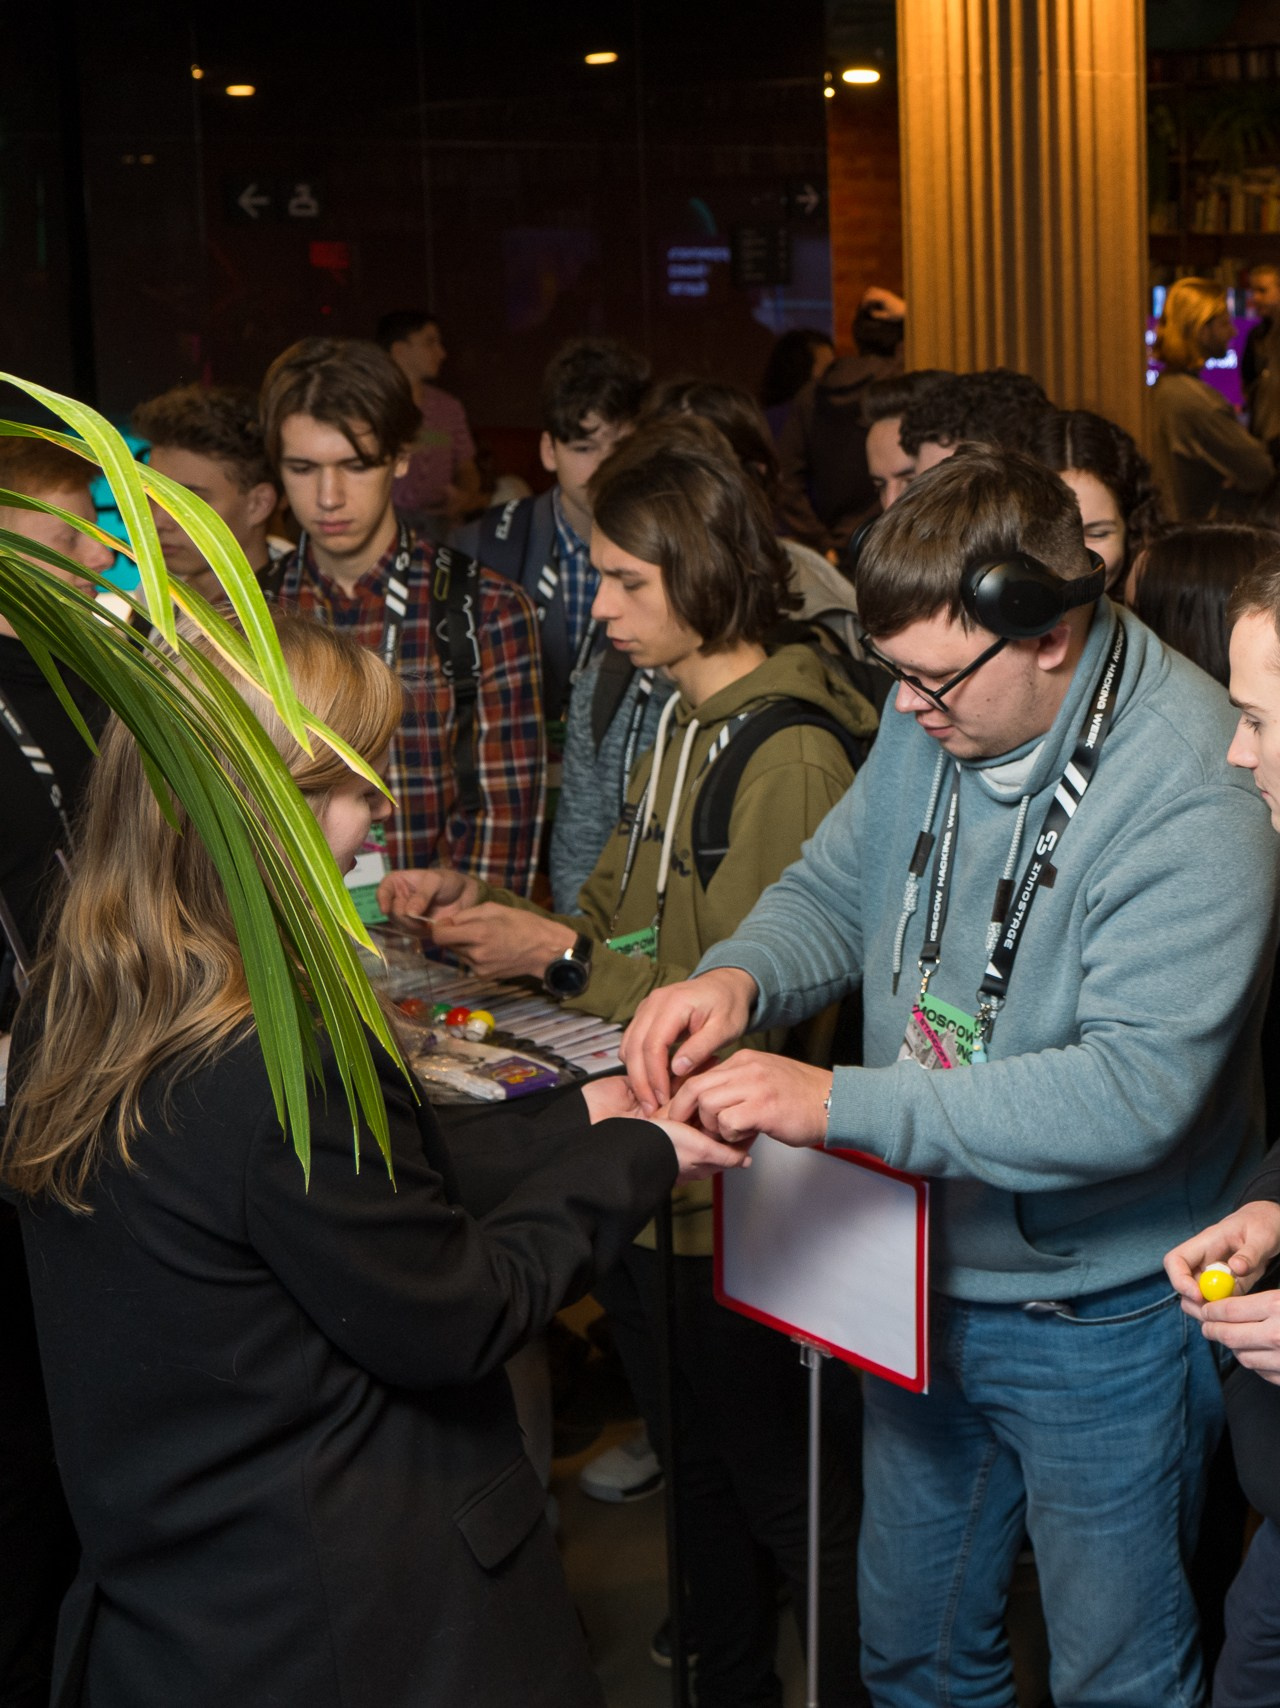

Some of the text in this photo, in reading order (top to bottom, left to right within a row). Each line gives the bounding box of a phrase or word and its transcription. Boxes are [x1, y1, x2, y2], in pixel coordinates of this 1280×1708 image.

[1097, 663, 1116, 710] HACKING
[1085, 713, 1103, 749] WEEK
[937, 831, 952, 887] HACKING
[946, 793, 958, 829] WEEK
